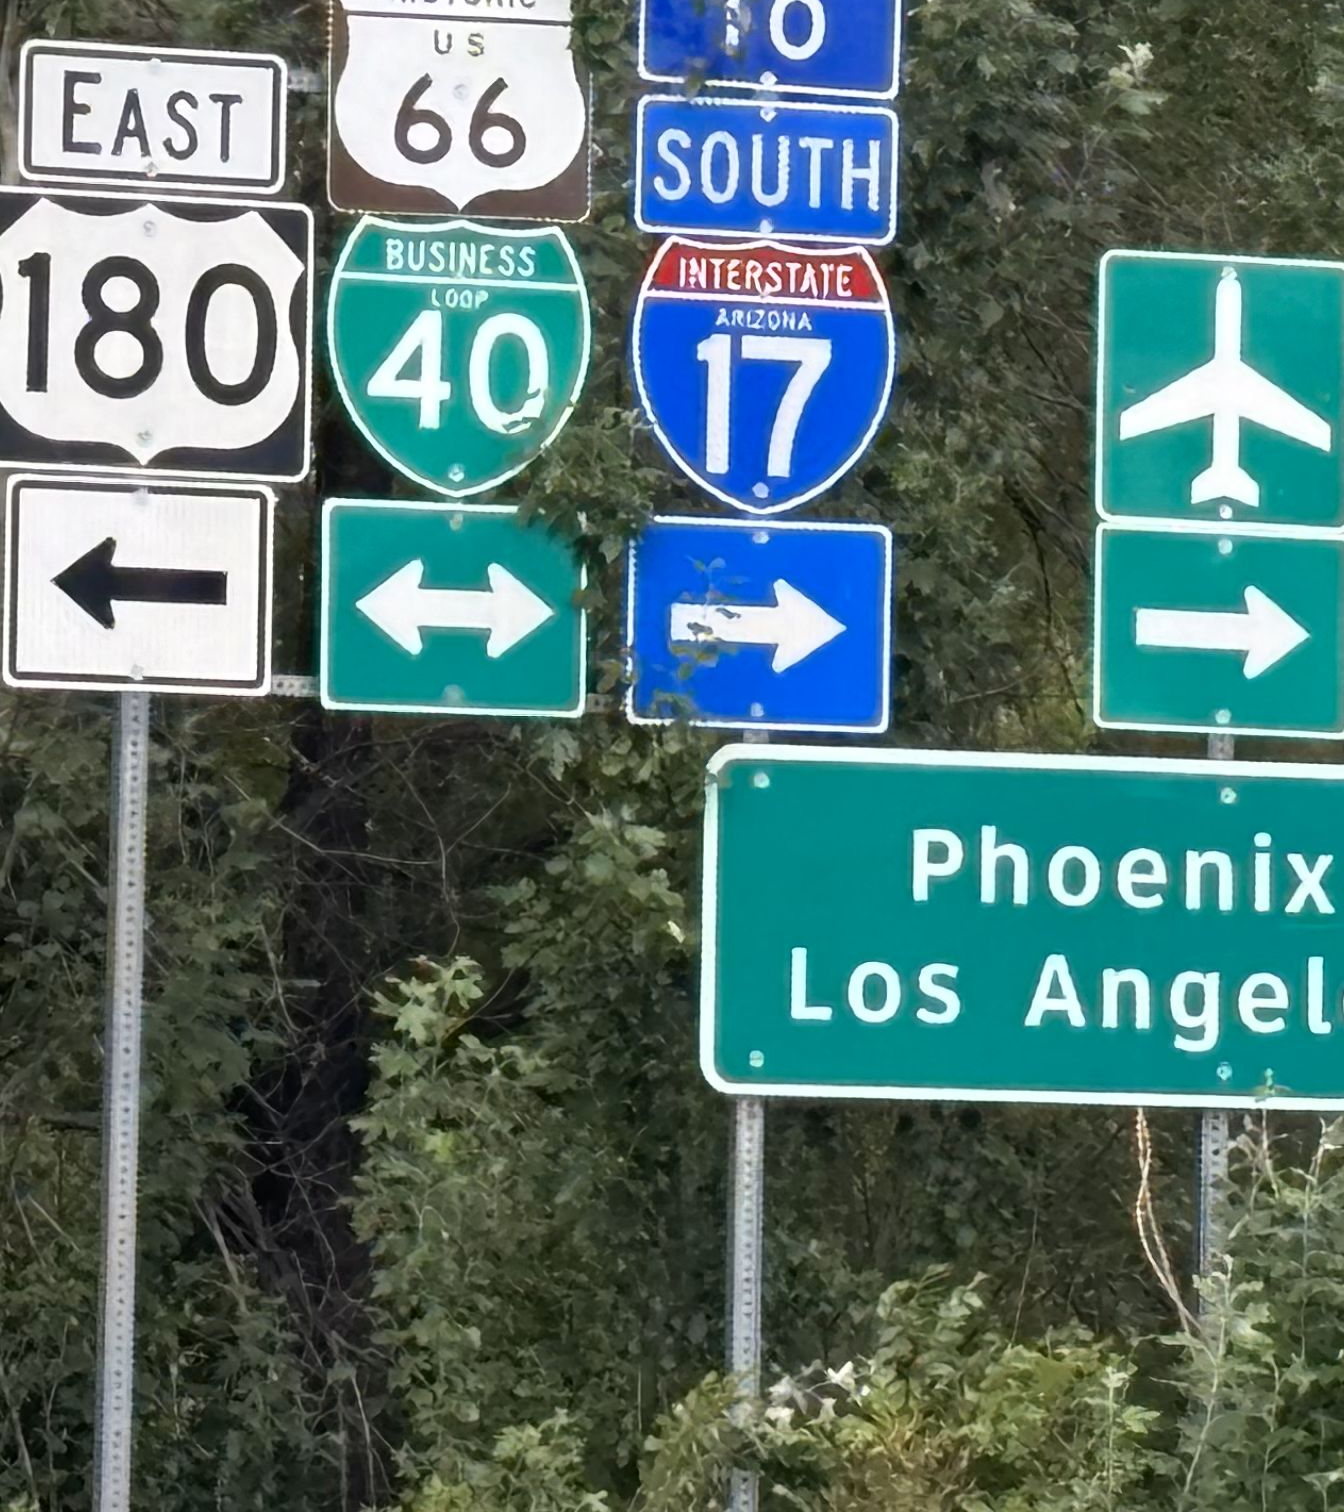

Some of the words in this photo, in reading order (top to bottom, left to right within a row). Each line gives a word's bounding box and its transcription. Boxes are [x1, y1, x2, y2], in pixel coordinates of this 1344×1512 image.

[61, 69, 244, 163] EAST
[394, 73, 527, 169] 66
[653, 128, 881, 212] SOUTH
[385, 238, 537, 278] BUSINESS
[429, 286, 490, 310] LOOP
[678, 256, 854, 298] INTERSTATE
[17, 252, 278, 407] 180
[714, 307, 813, 332] ARIZONA
[366, 309, 550, 435] 40
[696, 333, 833, 479] 17
[911, 824, 1337, 916] Phoenix
[789, 947, 962, 1026] Los
